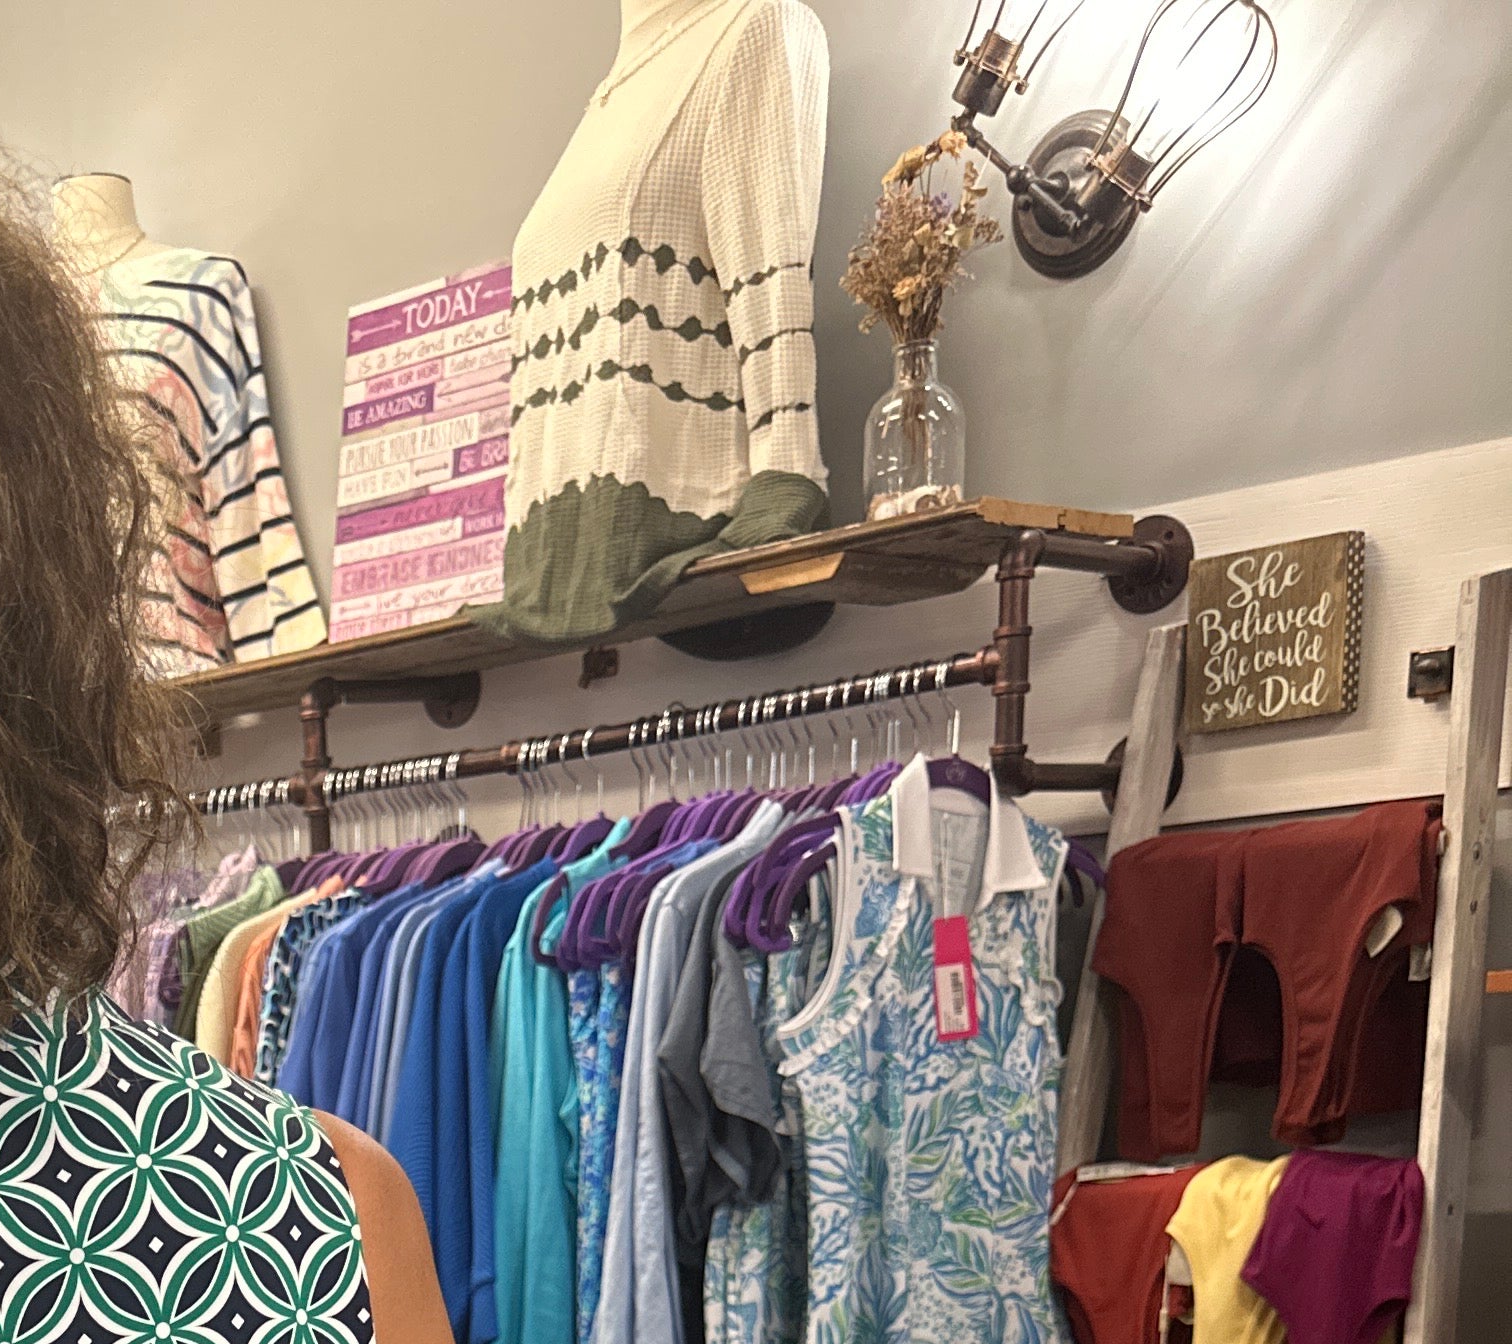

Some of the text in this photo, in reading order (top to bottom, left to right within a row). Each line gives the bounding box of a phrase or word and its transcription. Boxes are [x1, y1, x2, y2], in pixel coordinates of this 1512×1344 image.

[402, 281, 483, 334] TODAY
[392, 333, 445, 366] brand
[453, 324, 489, 347] new
[366, 391, 426, 425] AMAZING
[420, 416, 474, 448] PASSION
[341, 555, 422, 595] EMBRACE
[1226, 551, 1304, 608] She
[1195, 592, 1335, 655] Believed
[1203, 630, 1327, 695] She could
[1201, 667, 1333, 724] so she Did
